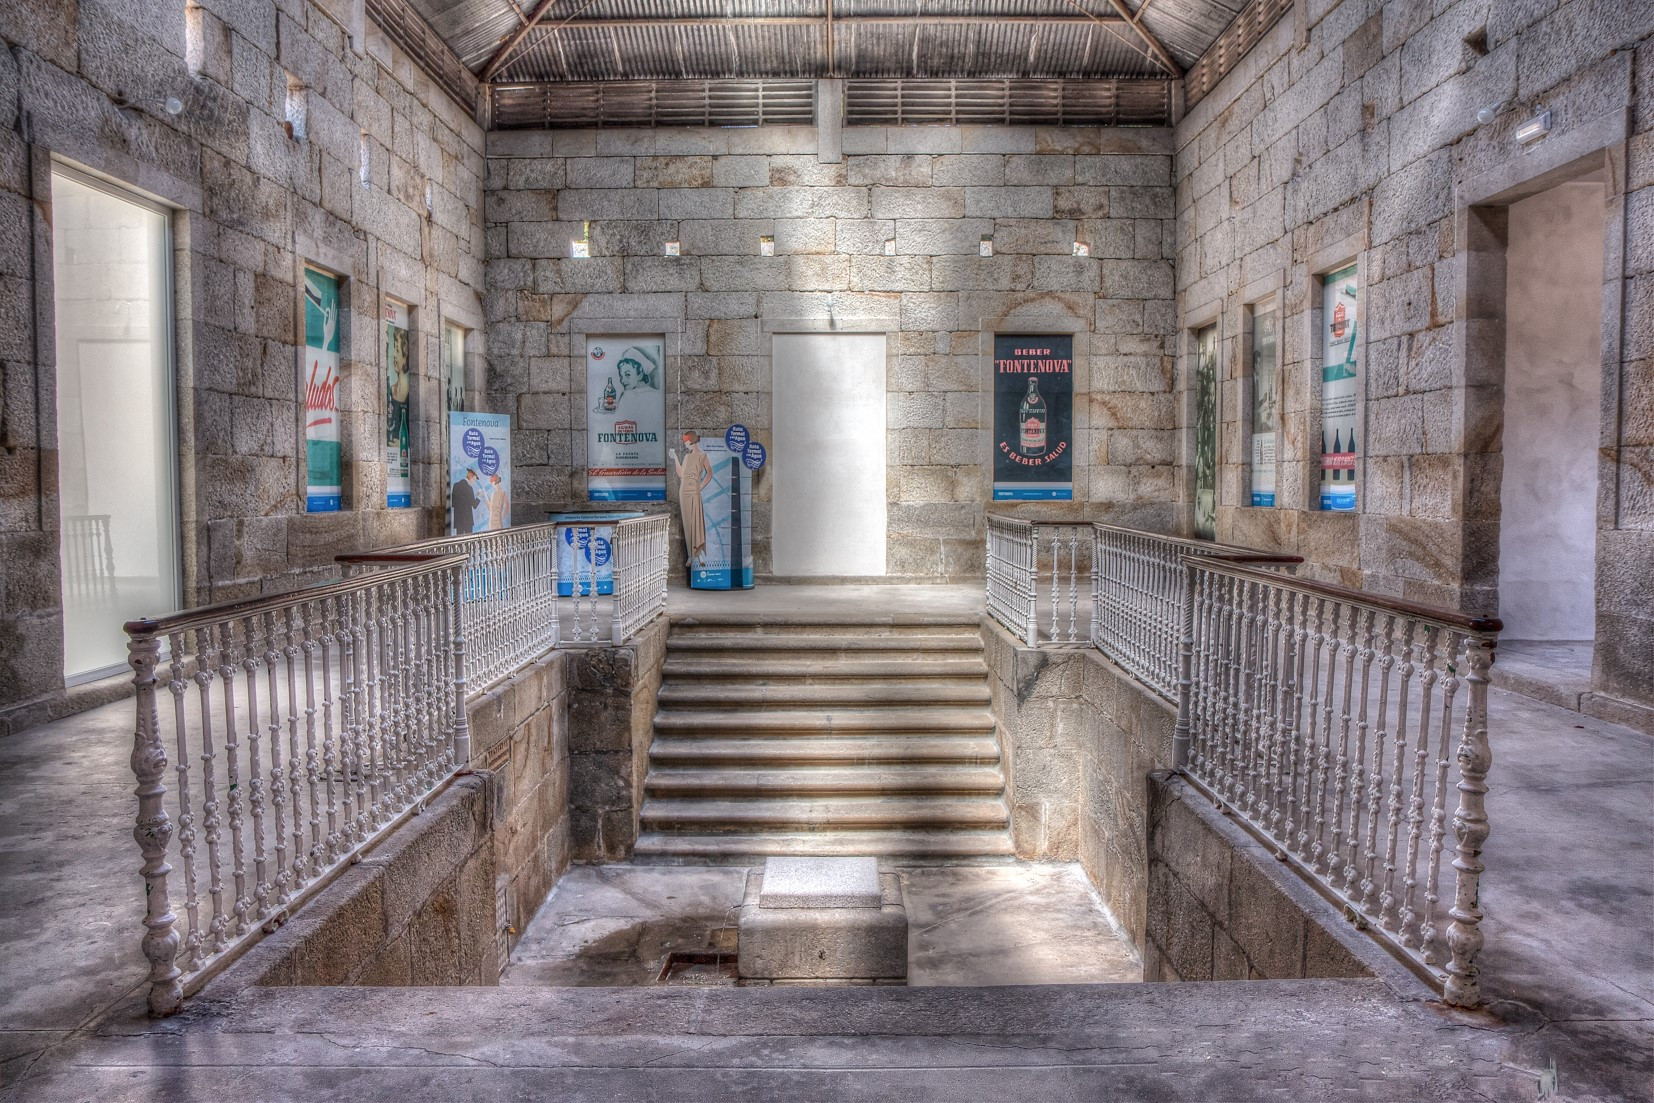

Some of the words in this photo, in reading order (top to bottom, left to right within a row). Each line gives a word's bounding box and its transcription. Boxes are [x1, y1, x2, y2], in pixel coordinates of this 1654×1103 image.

[1014, 348, 1051, 356] BEBER
[994, 359, 1072, 373] "FONTENOVA"
[463, 417, 498, 427] Fontenova
[597, 433, 657, 442] FONTENOVA
[1000, 441, 1010, 453] ES
[1009, 452, 1042, 466] BEBER
[1044, 441, 1067, 463] SALUD
